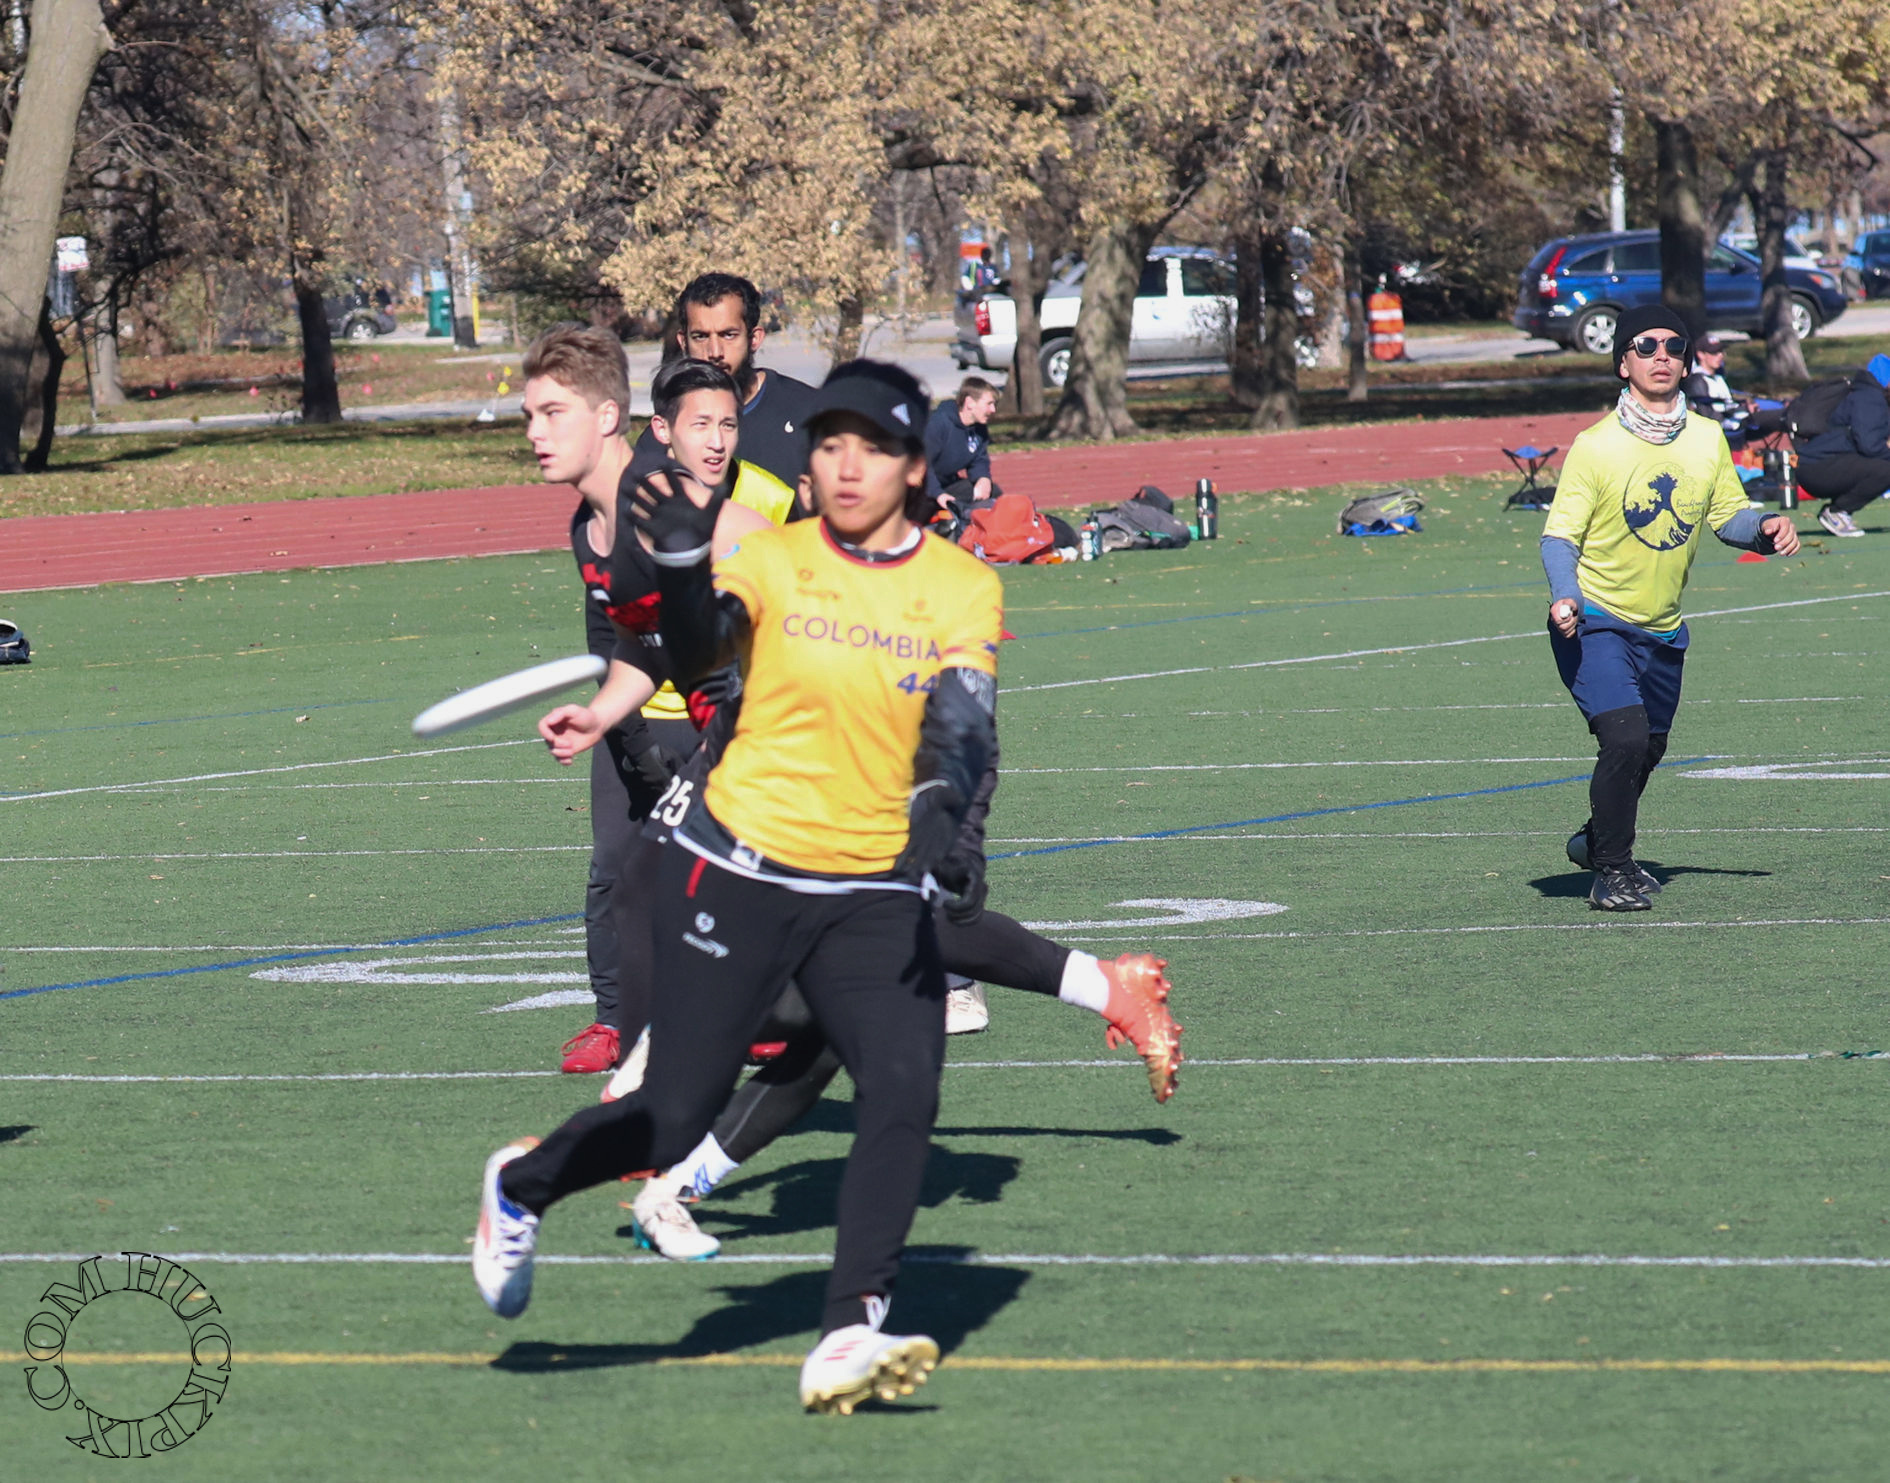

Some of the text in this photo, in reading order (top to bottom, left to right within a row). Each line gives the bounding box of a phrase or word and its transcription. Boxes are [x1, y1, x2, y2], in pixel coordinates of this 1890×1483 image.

[783, 613, 942, 662] COLOMBIA
[897, 672, 940, 695] 44
[649, 774, 695, 828] 25
